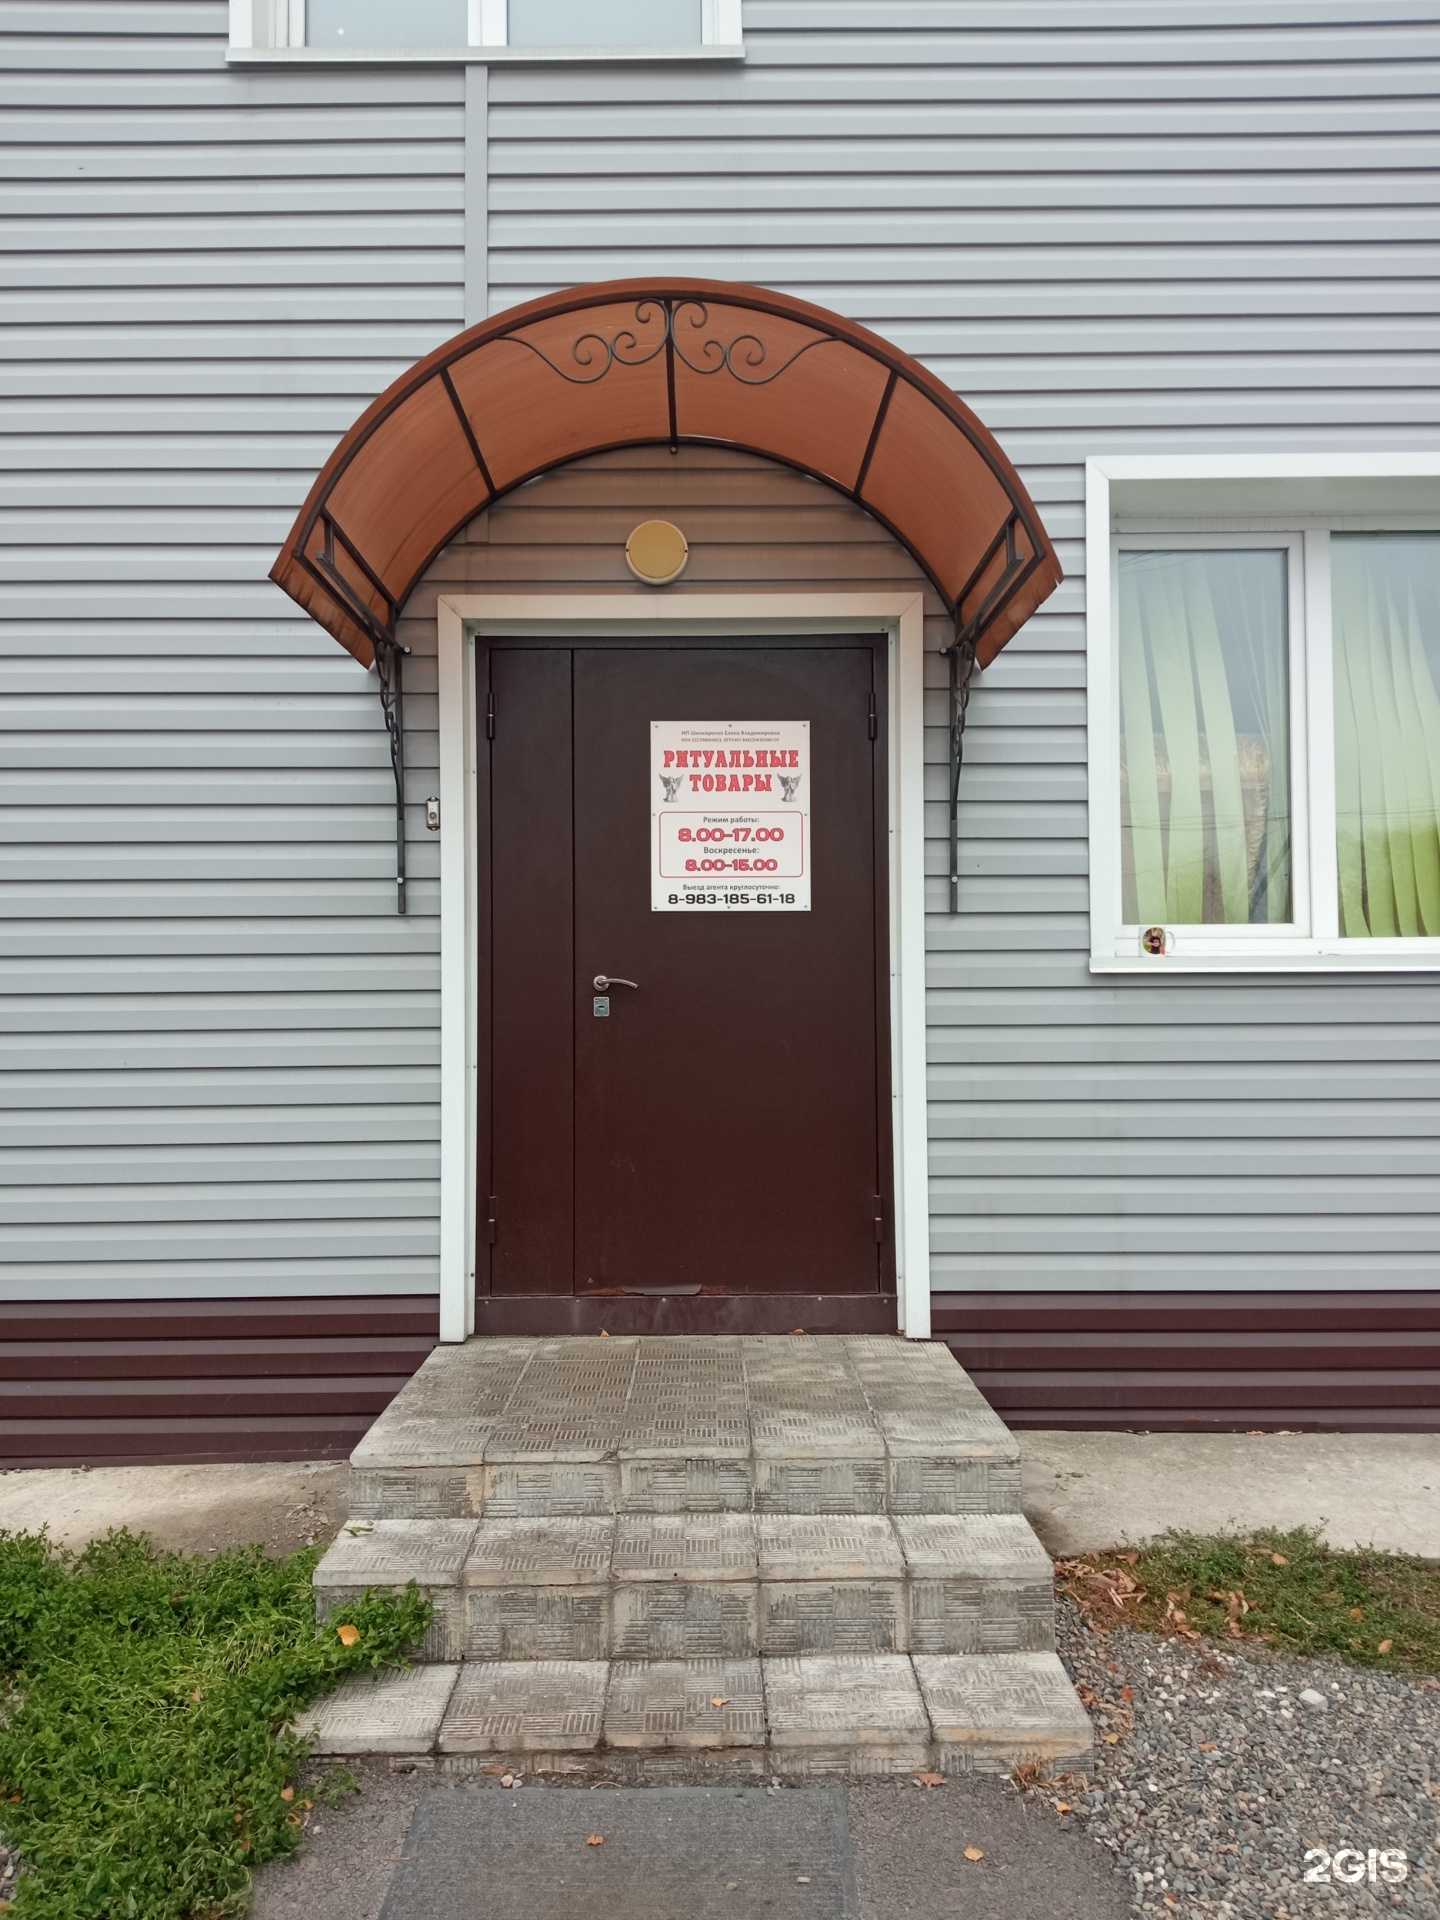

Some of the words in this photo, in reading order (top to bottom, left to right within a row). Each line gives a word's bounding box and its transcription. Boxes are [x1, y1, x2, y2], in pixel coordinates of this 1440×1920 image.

[663, 750, 799, 768] РИТУАЛЬНЫЕ
[689, 774, 772, 792] ТОВАРЫ
[703, 816, 729, 824] Режим
[730, 816, 760, 825] работы:
[678, 827, 784, 842] 8.00-17.00
[703, 846, 760, 855] Воскресенье:
[685, 858, 778, 872] 8.00-15.00
[668, 893, 796, 905] 8-983-185-61-18
